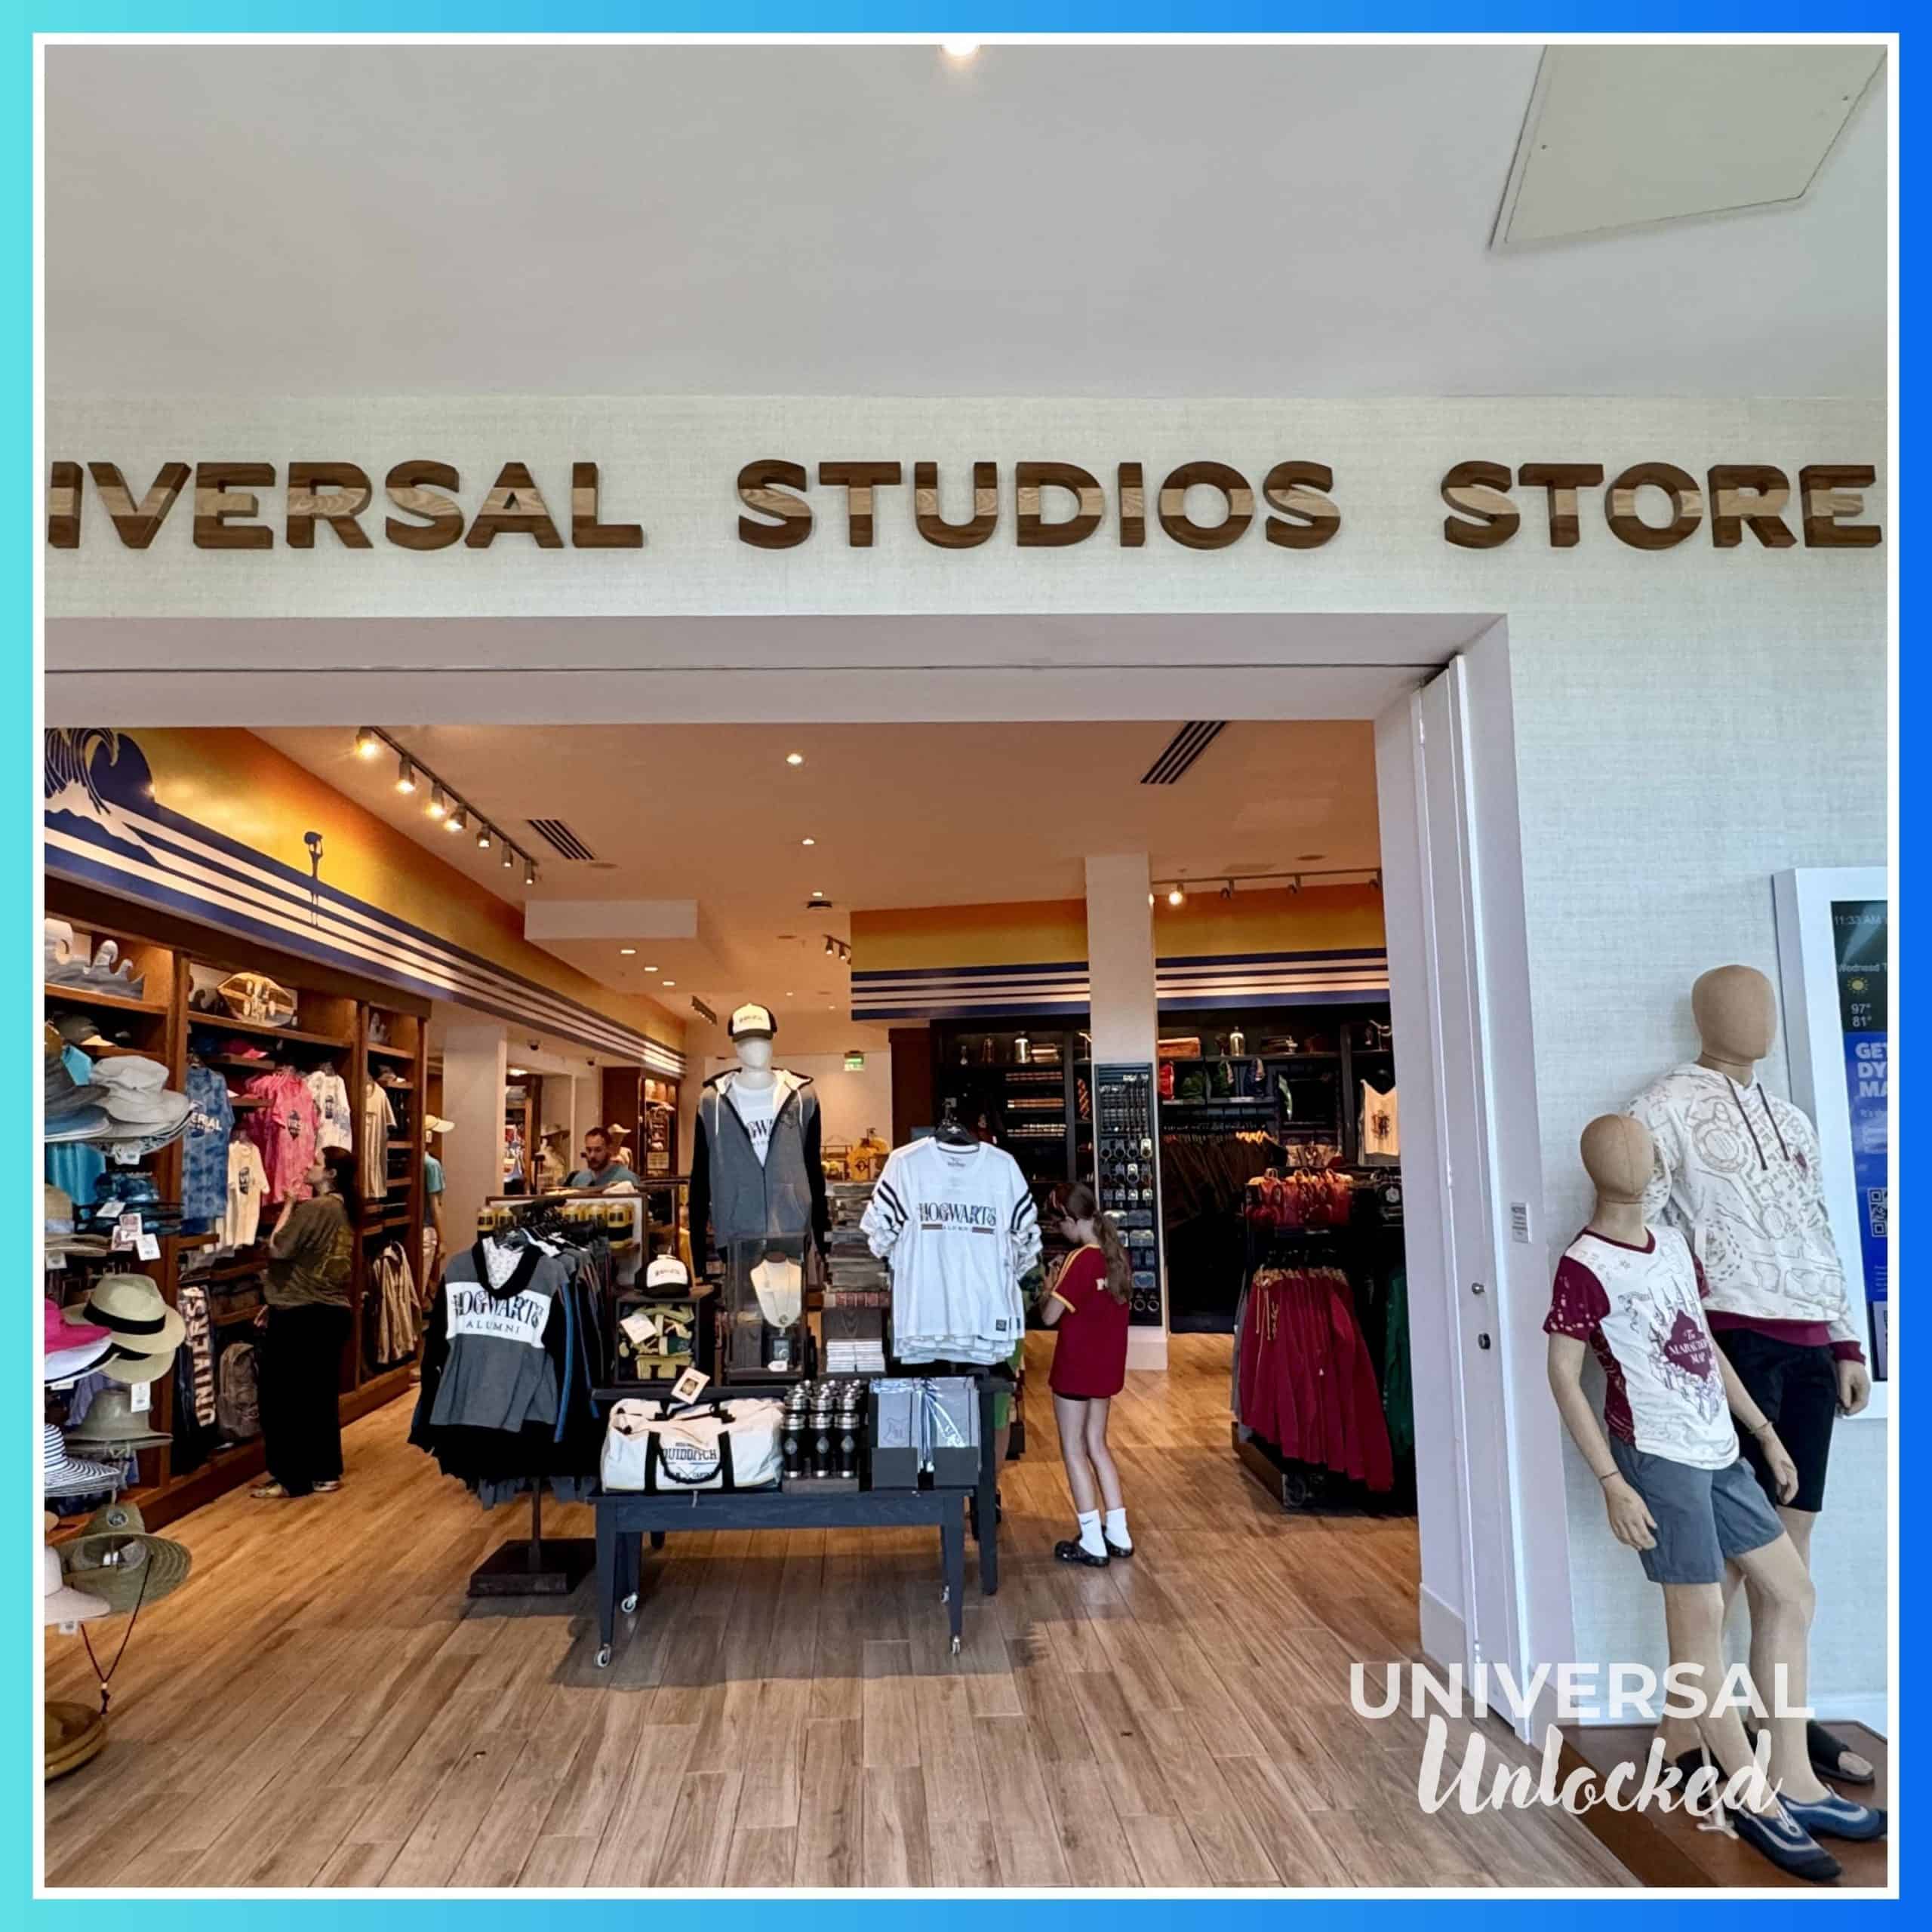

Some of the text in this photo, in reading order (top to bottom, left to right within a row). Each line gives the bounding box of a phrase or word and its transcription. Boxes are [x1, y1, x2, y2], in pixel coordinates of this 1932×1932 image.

[48, 459, 1883, 551] IVERSAL STUDIOS STORE
[1855, 1042, 1887, 1059] GE
[1858, 1062, 1887, 1078] DY
[918, 1201, 996, 1226] HOGWARTS
[466, 1321, 521, 1335] ALUMNI
